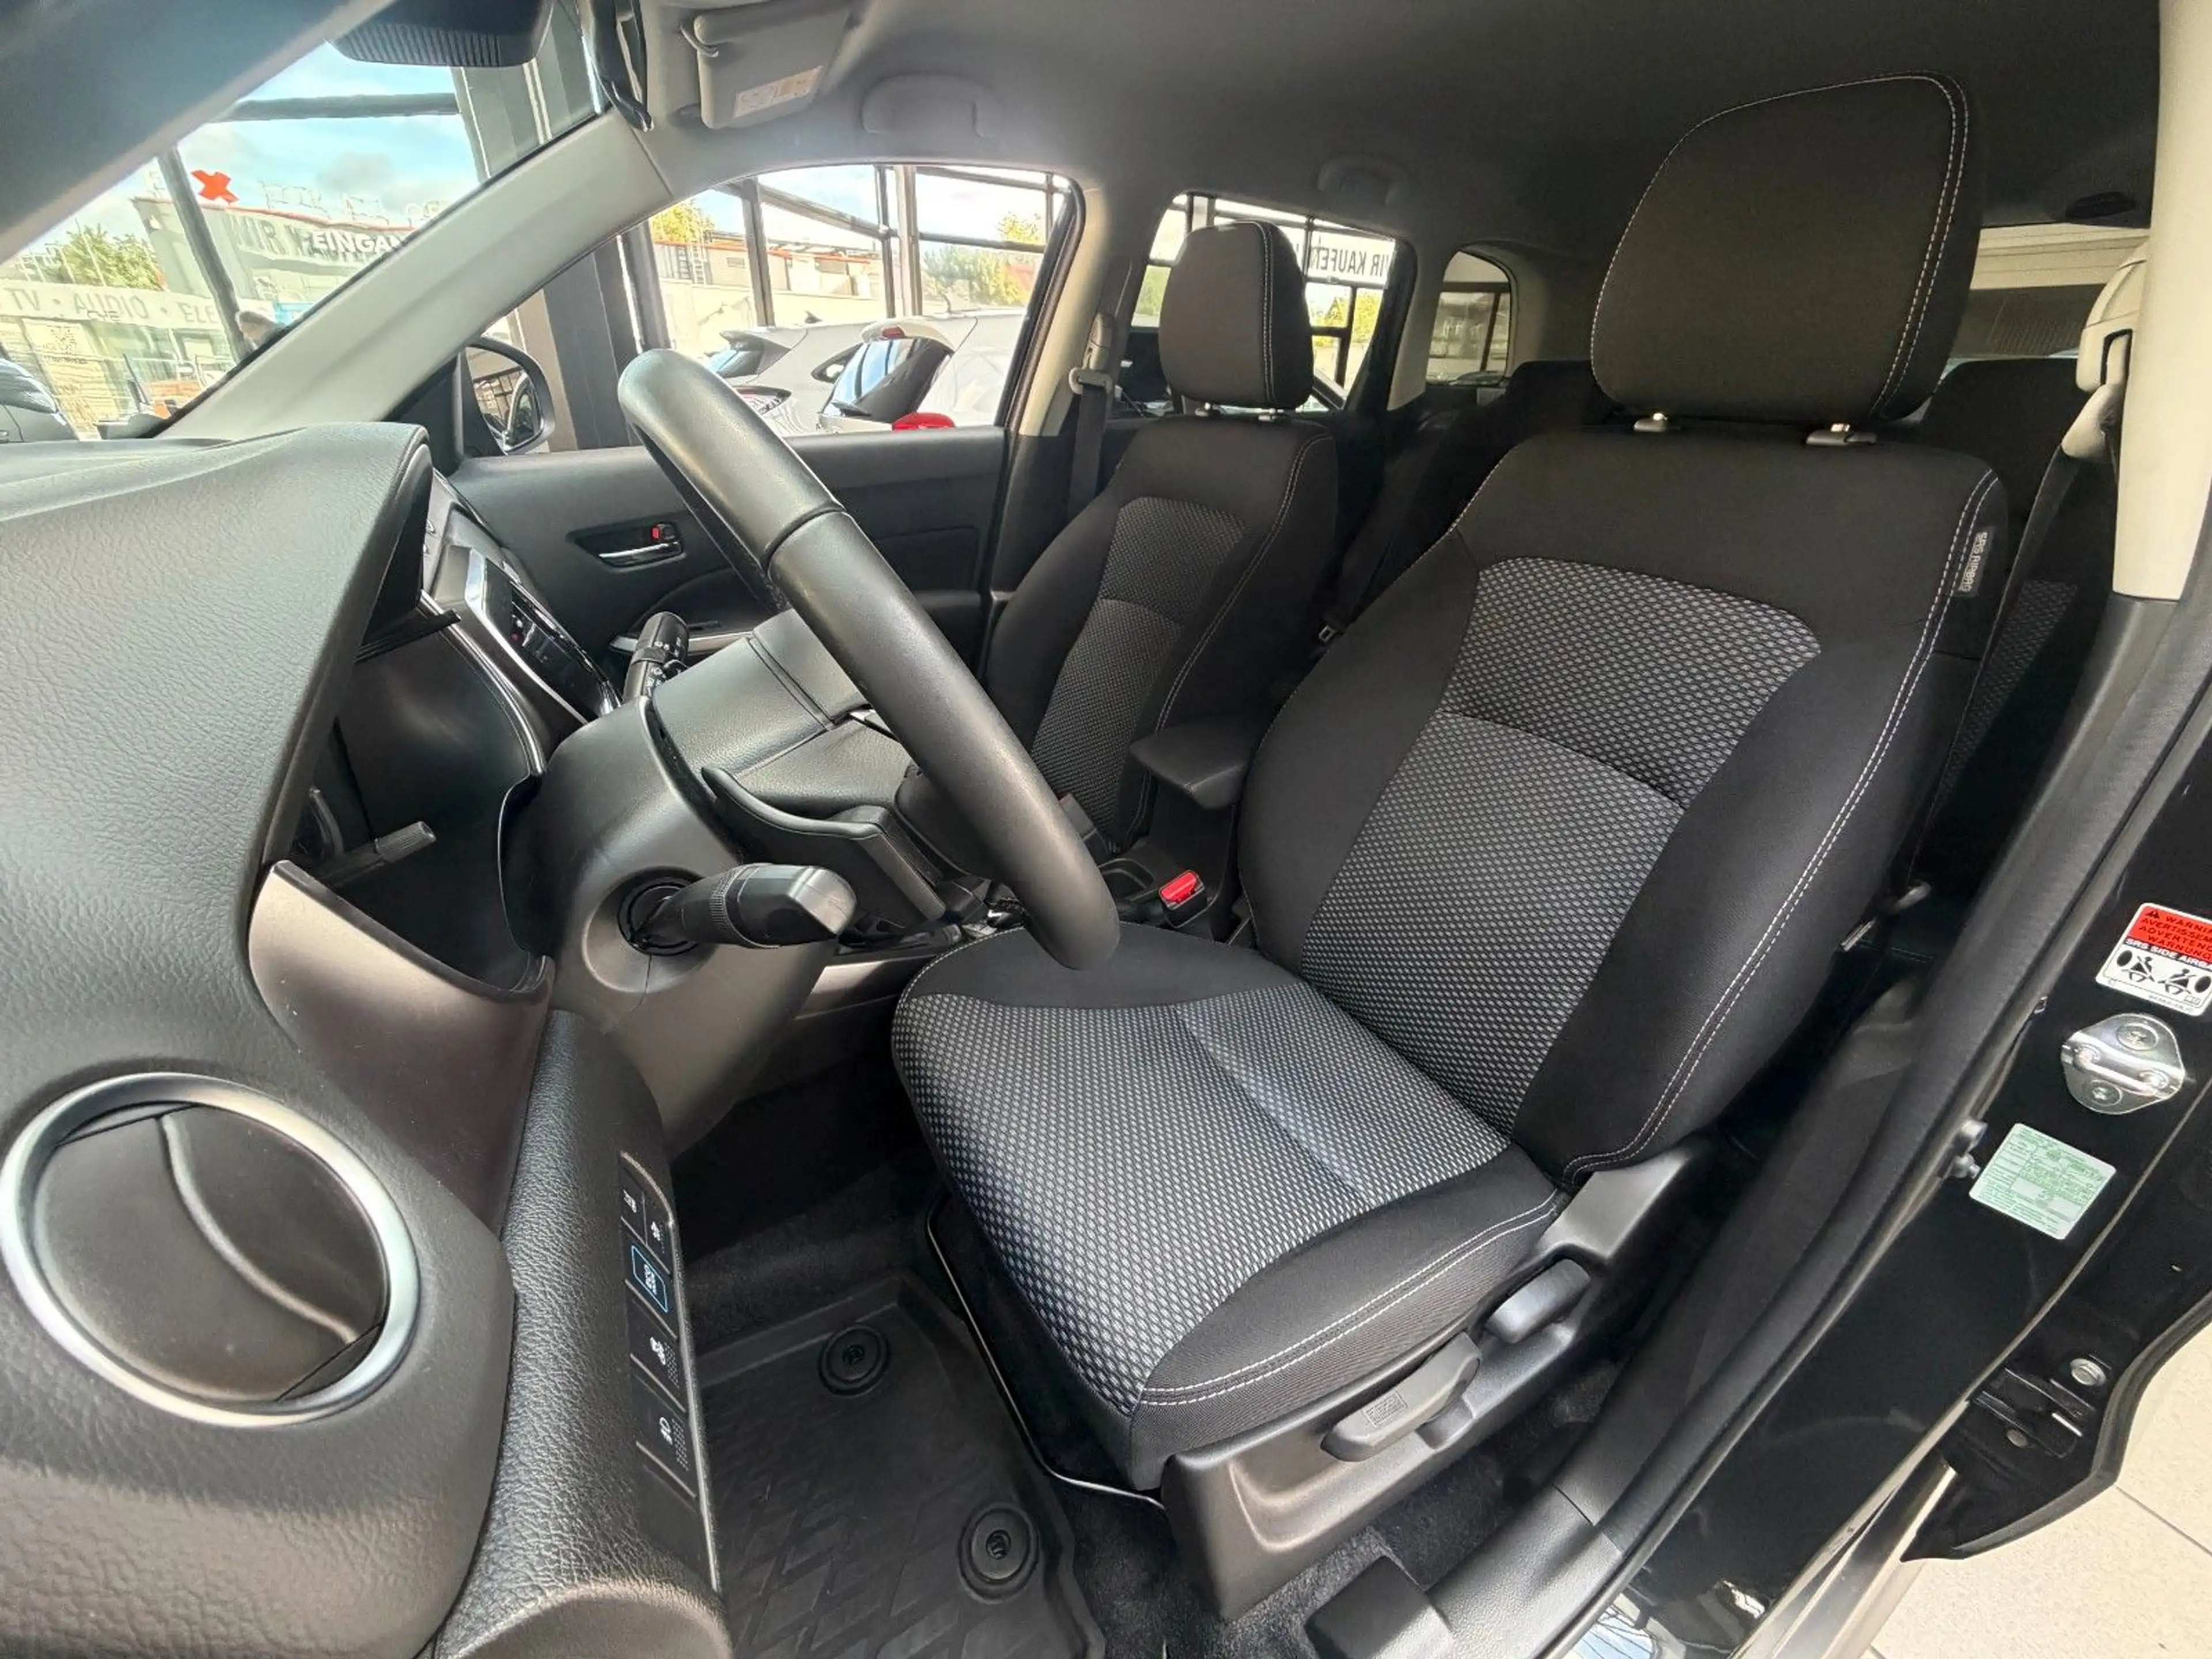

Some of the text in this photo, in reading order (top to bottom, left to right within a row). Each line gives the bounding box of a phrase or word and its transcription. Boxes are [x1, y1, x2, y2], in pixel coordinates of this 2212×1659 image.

[3, 288, 40, 310] TV
[73, 293, 150, 320] AUDIO
[2125, 938, 2149, 949] SRS
[2150, 945, 2177, 957] SIDE
[2148, 935, 2211, 960] WARNUNG
